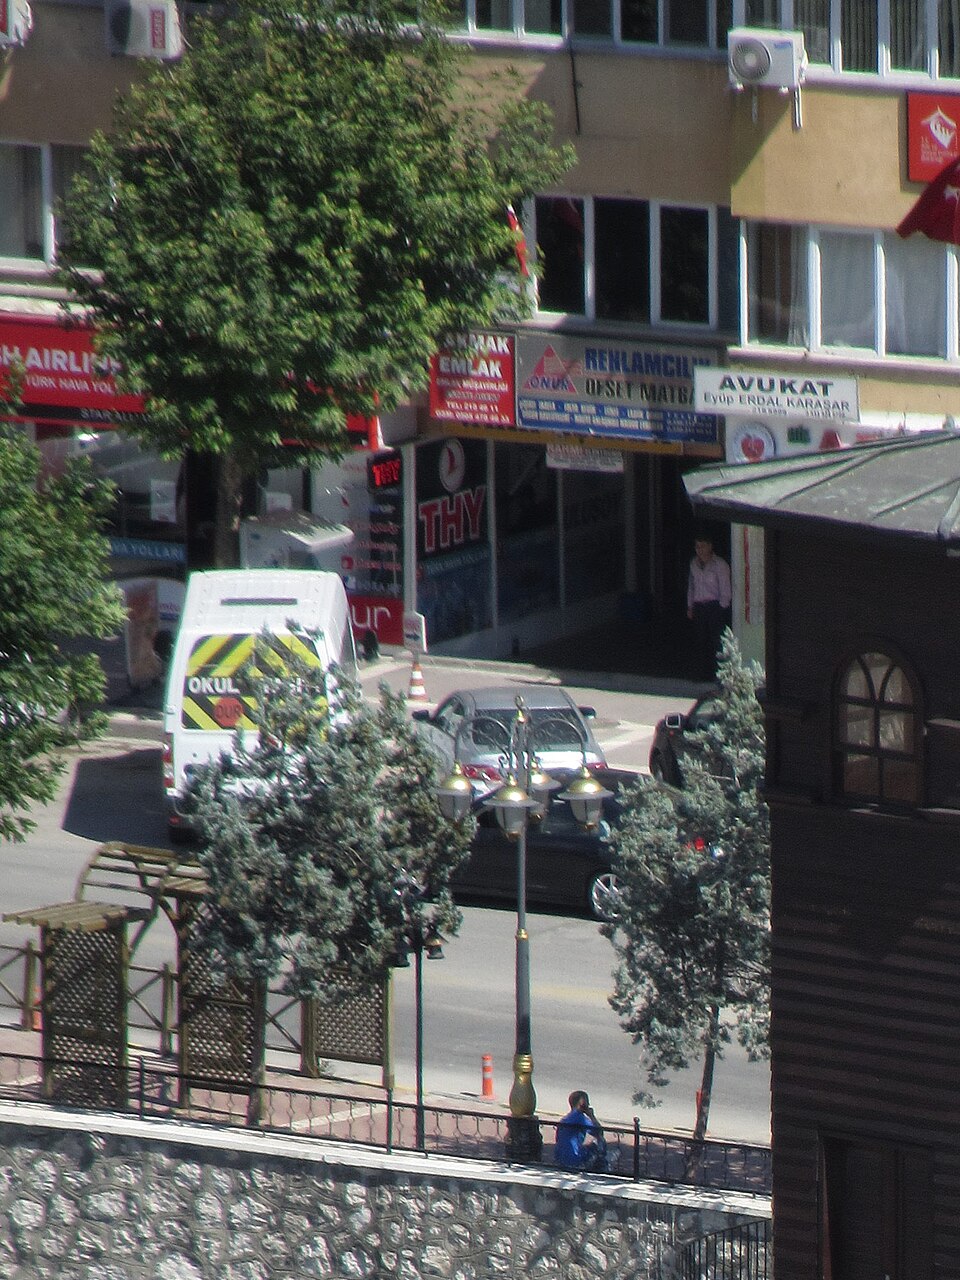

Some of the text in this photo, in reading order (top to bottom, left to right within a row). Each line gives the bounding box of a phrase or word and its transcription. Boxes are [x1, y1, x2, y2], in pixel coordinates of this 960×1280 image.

[439, 355, 503, 379] EMLAK
[529, 375, 570, 391] ONUR
[585, 377, 633, 399] OFSET
[719, 374, 834, 397] AVUKAT
[703, 391, 734, 406] Eyüp
[738, 394, 783, 408] ERDAL
[786, 397, 851, 412] KARASAR
[418, 484, 487, 553] THY
[188, 676, 241, 695] OKUL
